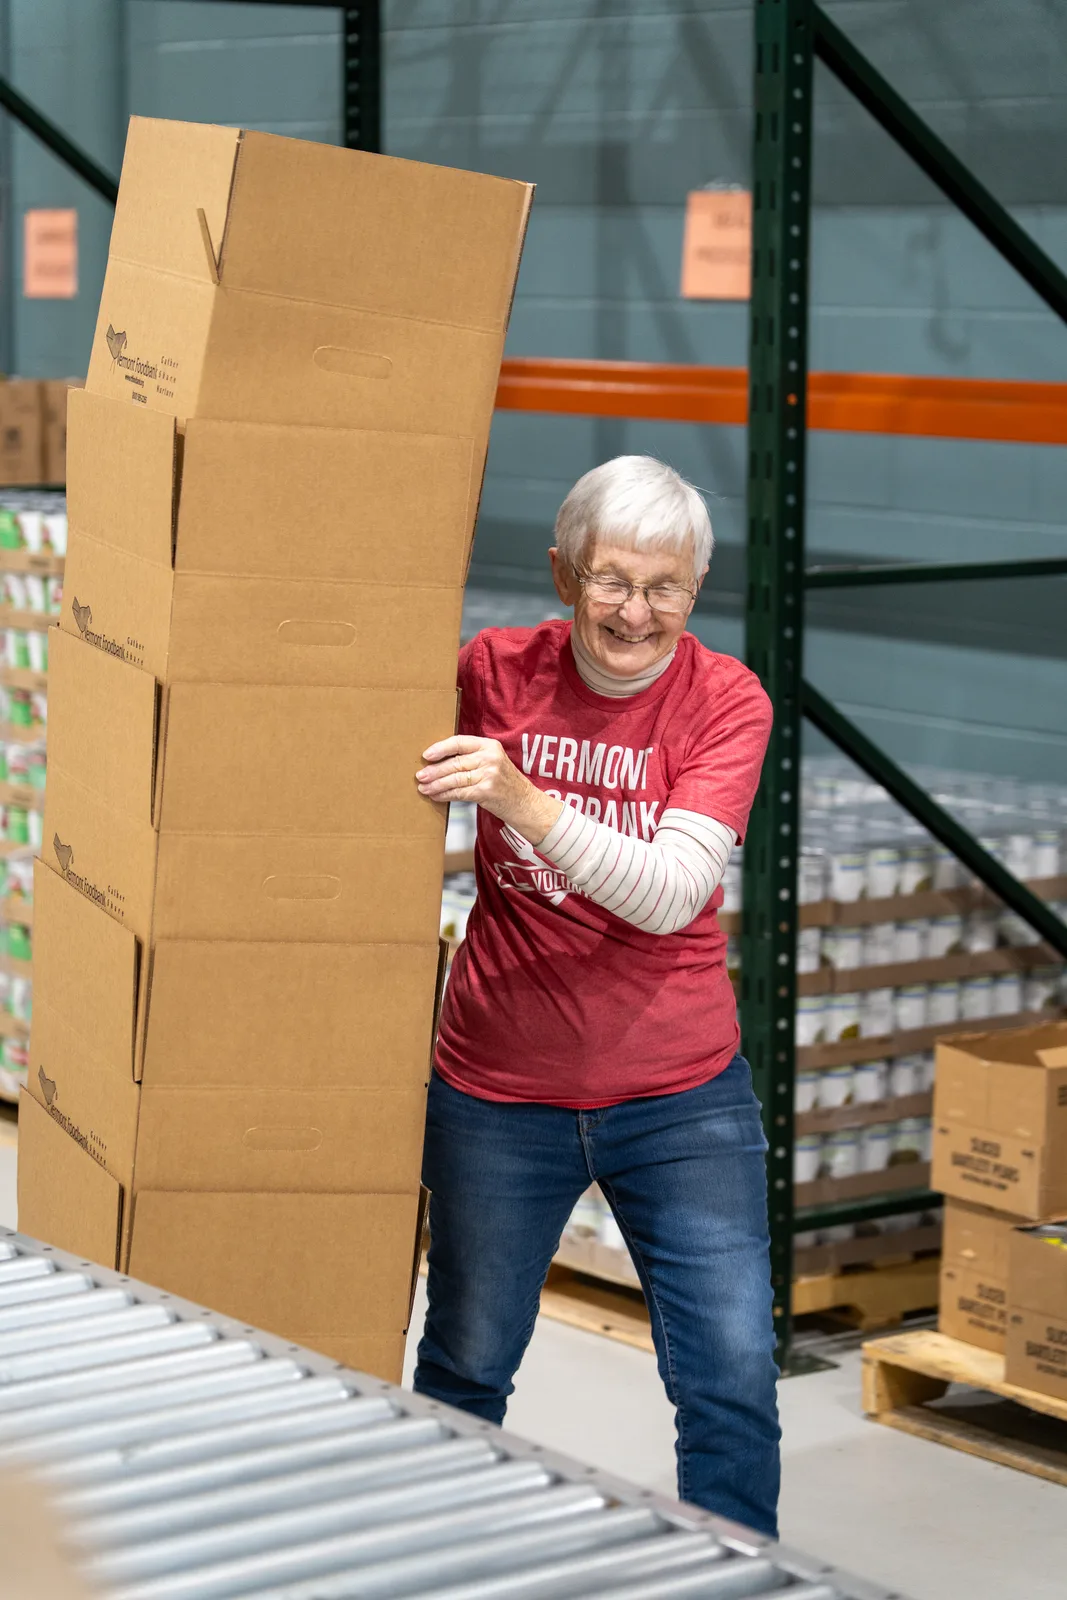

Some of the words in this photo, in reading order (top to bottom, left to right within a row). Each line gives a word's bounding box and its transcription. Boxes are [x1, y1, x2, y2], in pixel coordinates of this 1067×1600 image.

[135, 357, 159, 379] Foodbank
[102, 634, 126, 660] Foodbank
[521, 733, 653, 790] VERMONT
